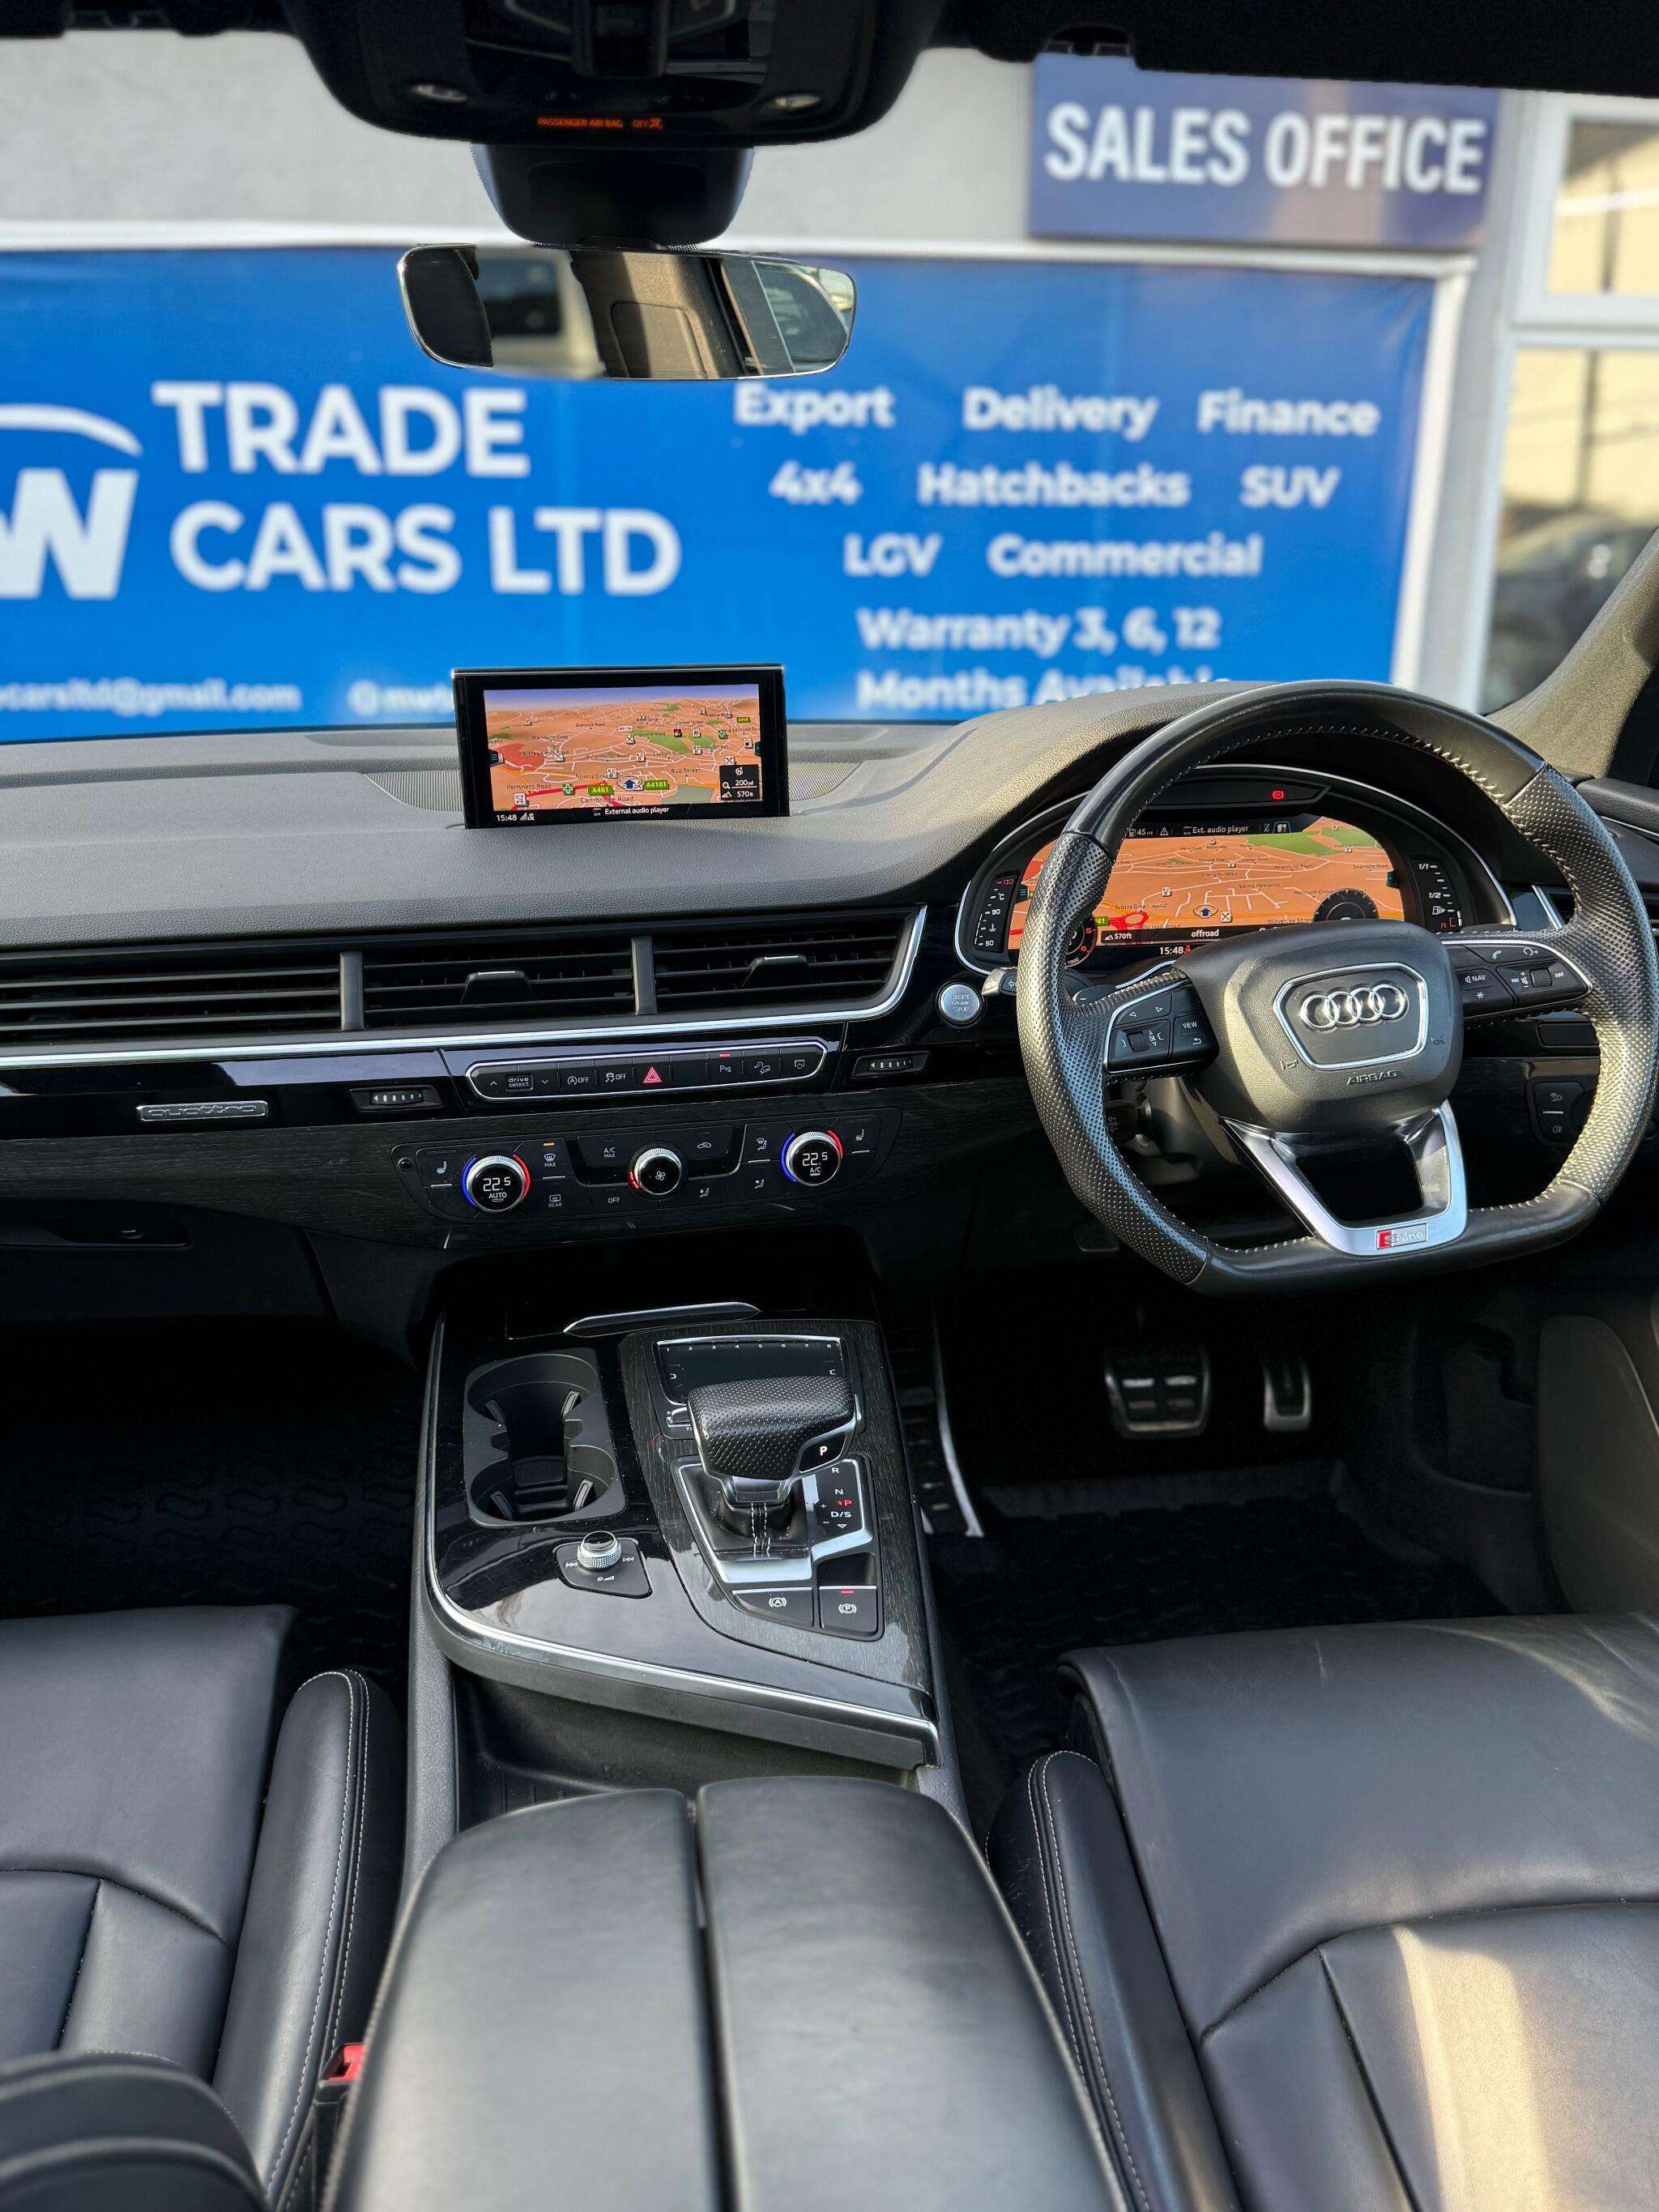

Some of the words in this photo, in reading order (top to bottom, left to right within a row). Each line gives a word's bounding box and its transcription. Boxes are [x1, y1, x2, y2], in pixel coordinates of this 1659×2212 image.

[538, 117, 587, 126] PASSENGER
[589, 118, 603, 127] AIR
[605, 119, 623, 128] BAG
[1045, 102, 1252, 187] SALES
[1265, 112, 1487, 194] OFFICE
[732, 381, 896, 435] Export
[962, 386, 1160, 441] Delivery
[1196, 389, 1382, 438] Finance
[151, 381, 531, 478] TRADE
[768, 460, 862, 506] 4x4
[916, 462, 1192, 509] Hatchbacks
[1239, 465, 1341, 510] SUV
[169, 501, 463, 594] CARS
[489, 506, 683, 596] LTD
[842, 532, 942, 579] LGV
[986, 532, 1264, 579] Commercial
[855, 606, 1071, 659] Warranty
[1073, 608, 1118, 655] 3,
[1123, 609, 1169, 655] 6,
[1174, 609, 1222, 648] 12
[855, 669, 1027, 710] Months
[592, 786, 609, 794] A461
[646, 780, 667, 789] A4101
[496, 813, 518, 822] 15:48
[604, 807, 631, 815] External
[632, 805, 650, 813] audio
[650, 805, 670, 814] player
[1192, 826, 1206, 834] Ext.
[1207, 824, 1226, 833] audio
[1227, 824, 1249, 833] player
[1191, 929, 1219, 937] offroad
[1159, 946, 1184, 955] 15:48
[1472, 975, 1486, 983] NAV
[1182, 1021, 1197, 1029] VIEW
[615, 1072, 627, 1080] OFF
[1346, 1070, 1397, 1086] AIRBAG
[603, 1147, 616, 1155] A/C
[820, 1445, 828, 1456] P
